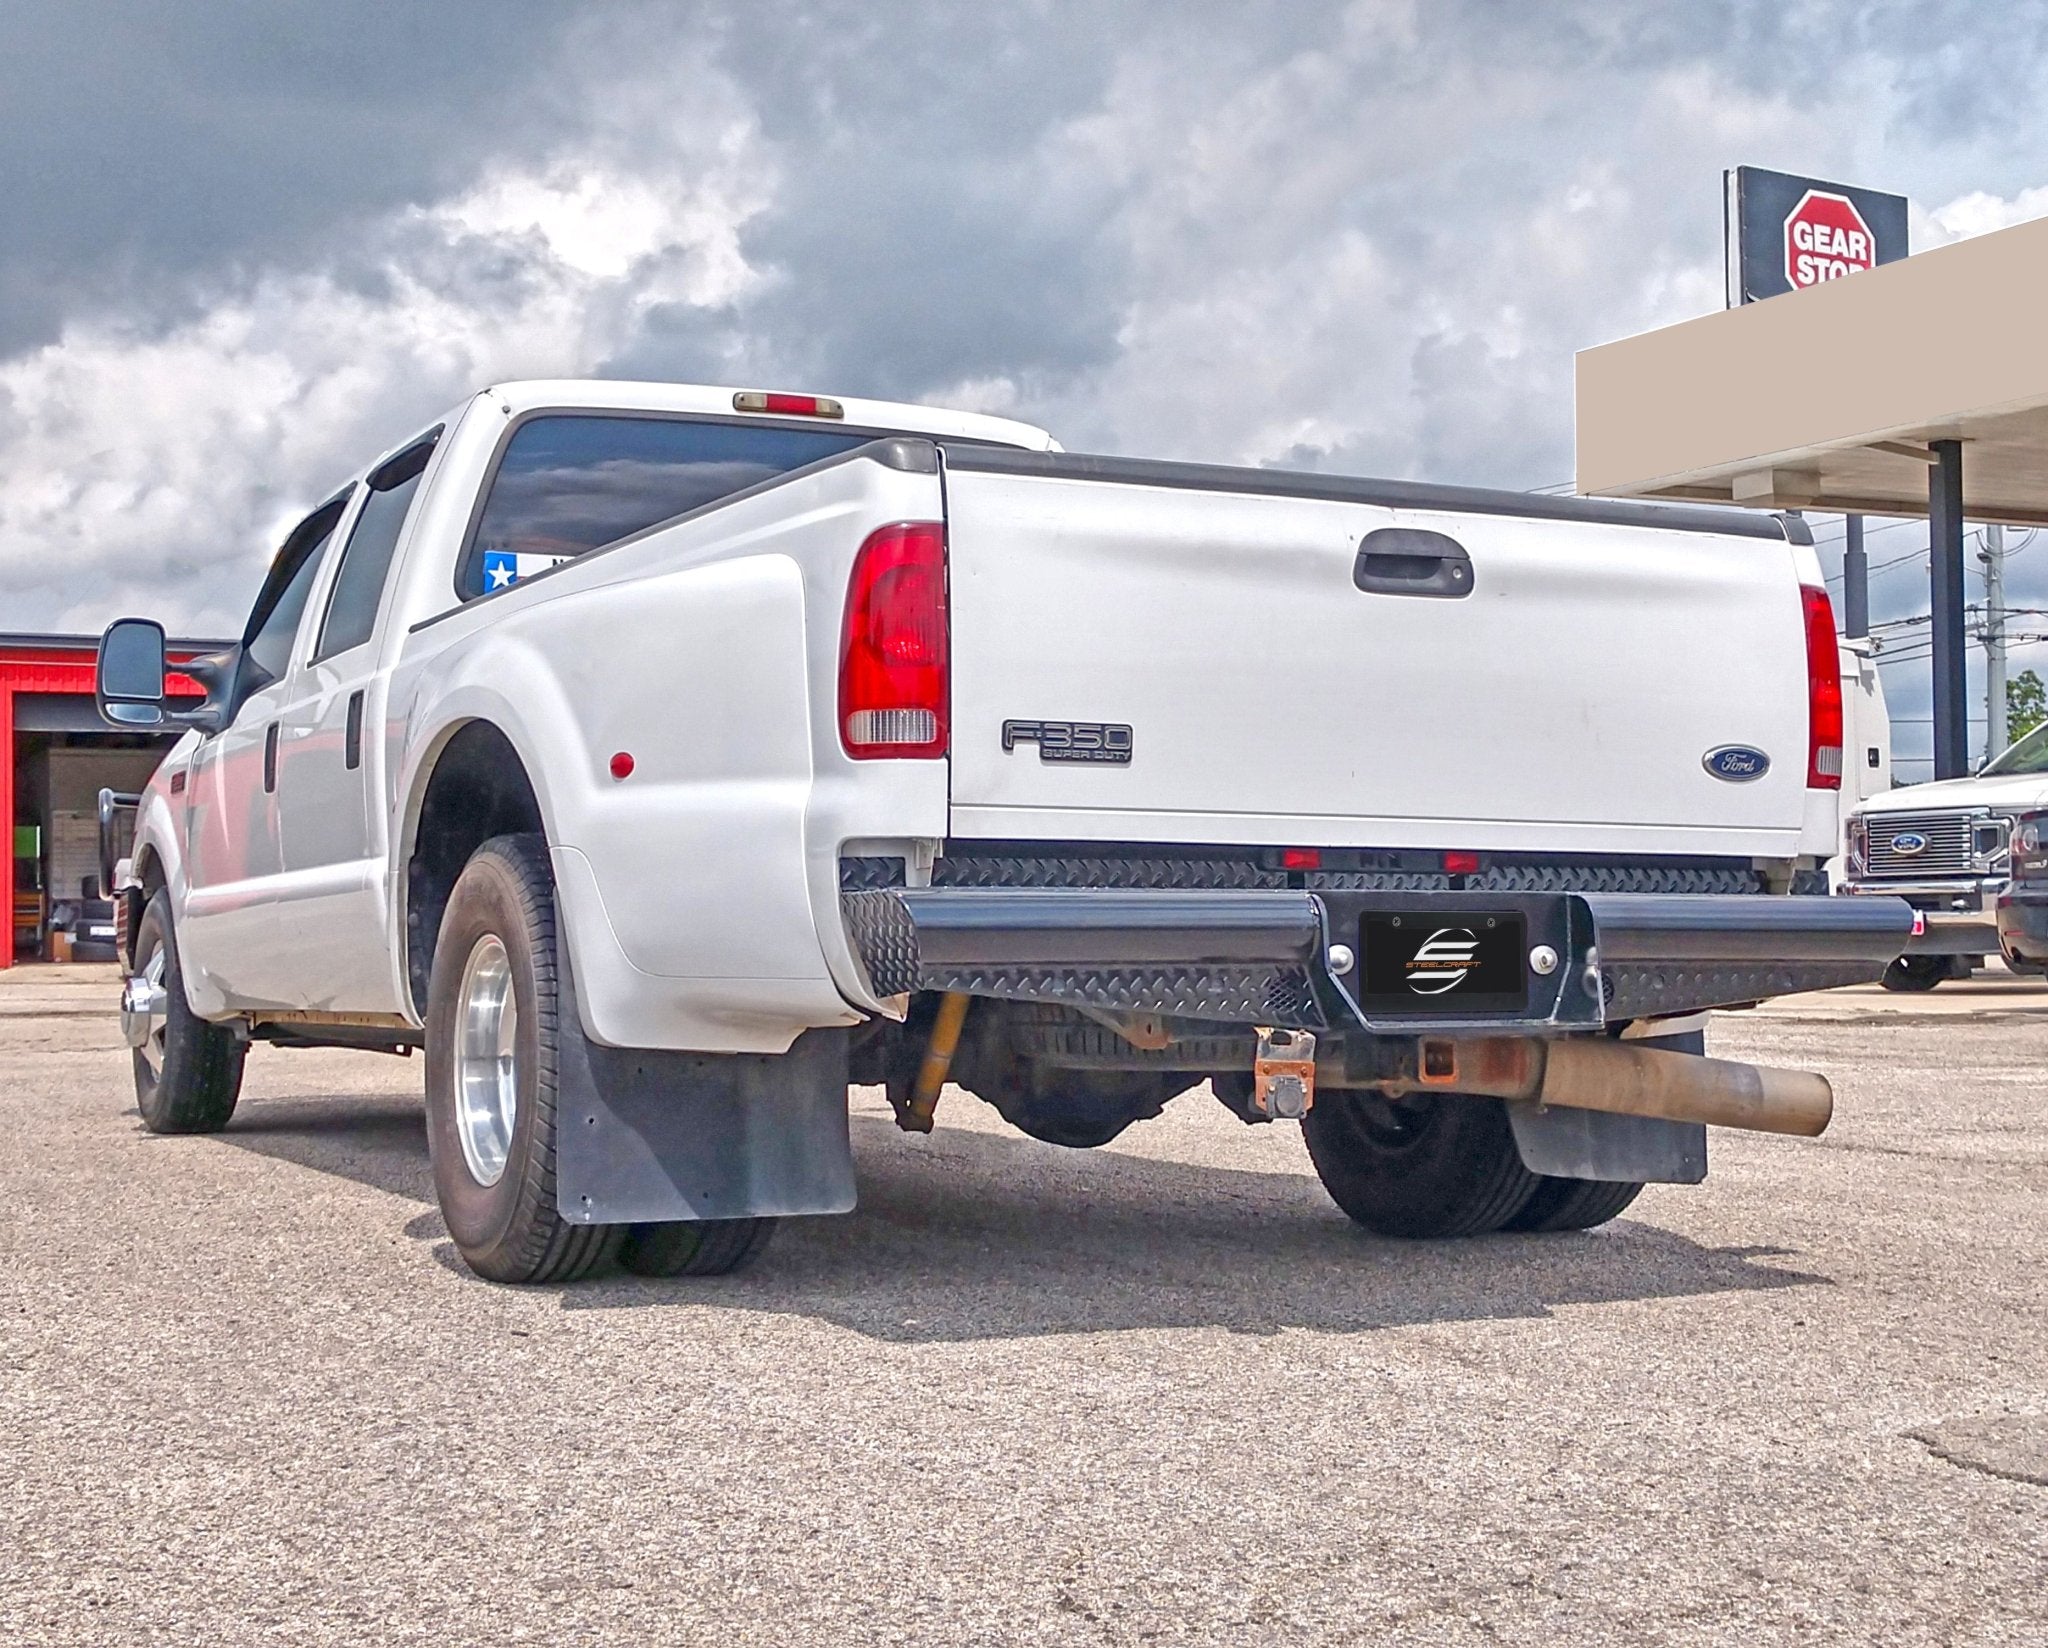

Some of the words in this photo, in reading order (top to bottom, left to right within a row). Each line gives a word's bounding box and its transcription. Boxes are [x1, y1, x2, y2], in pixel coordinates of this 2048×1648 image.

[1793, 220, 1867, 261] GEAR
[1042, 749, 1091, 759] SUPER
[1094, 751, 1131, 760] DUTY
[1721, 752, 1755, 772] Ford
[1405, 961, 1482, 969] STEELCRAFT
